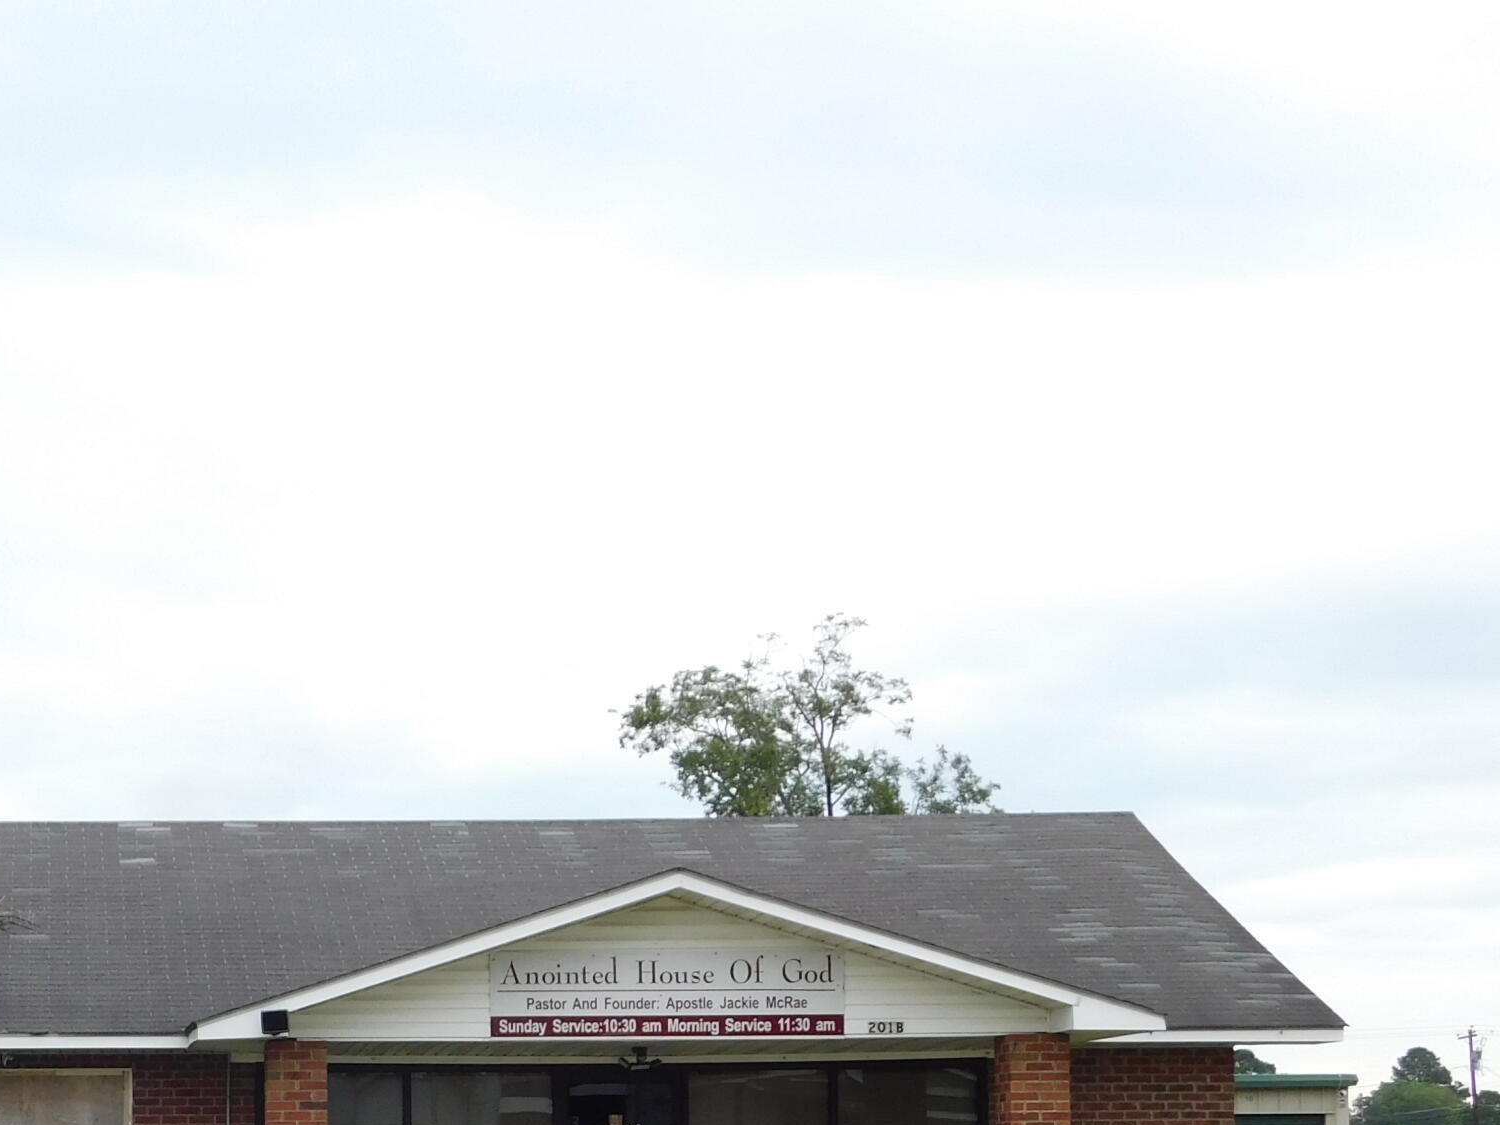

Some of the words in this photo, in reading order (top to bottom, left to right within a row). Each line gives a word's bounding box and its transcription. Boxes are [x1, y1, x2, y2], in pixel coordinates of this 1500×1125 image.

[501, 956, 619, 985] Anointed
[636, 959, 714, 985] House
[730, 955, 764, 983] Of
[782, 955, 834, 983] God
[527, 998, 566, 1010] Pastor
[572, 998, 597, 1010] And
[605, 997, 659, 1010] Founder:
[666, 996, 713, 1012] Apostle
[720, 996, 759, 1009] Jackie
[766, 997, 808, 1009] McRae
[499, 1019, 546, 1035] Sunday
[553, 1019, 636, 1032] Service:10:30
[642, 1022, 661, 1032] am
[668, 1019, 719, 1035] Morning
[725, 1019, 772, 1032] Service
[778, 1018, 810, 1031] 11:30
[816, 1022, 835, 1031] am
[868, 1022, 904, 1033] 201B
